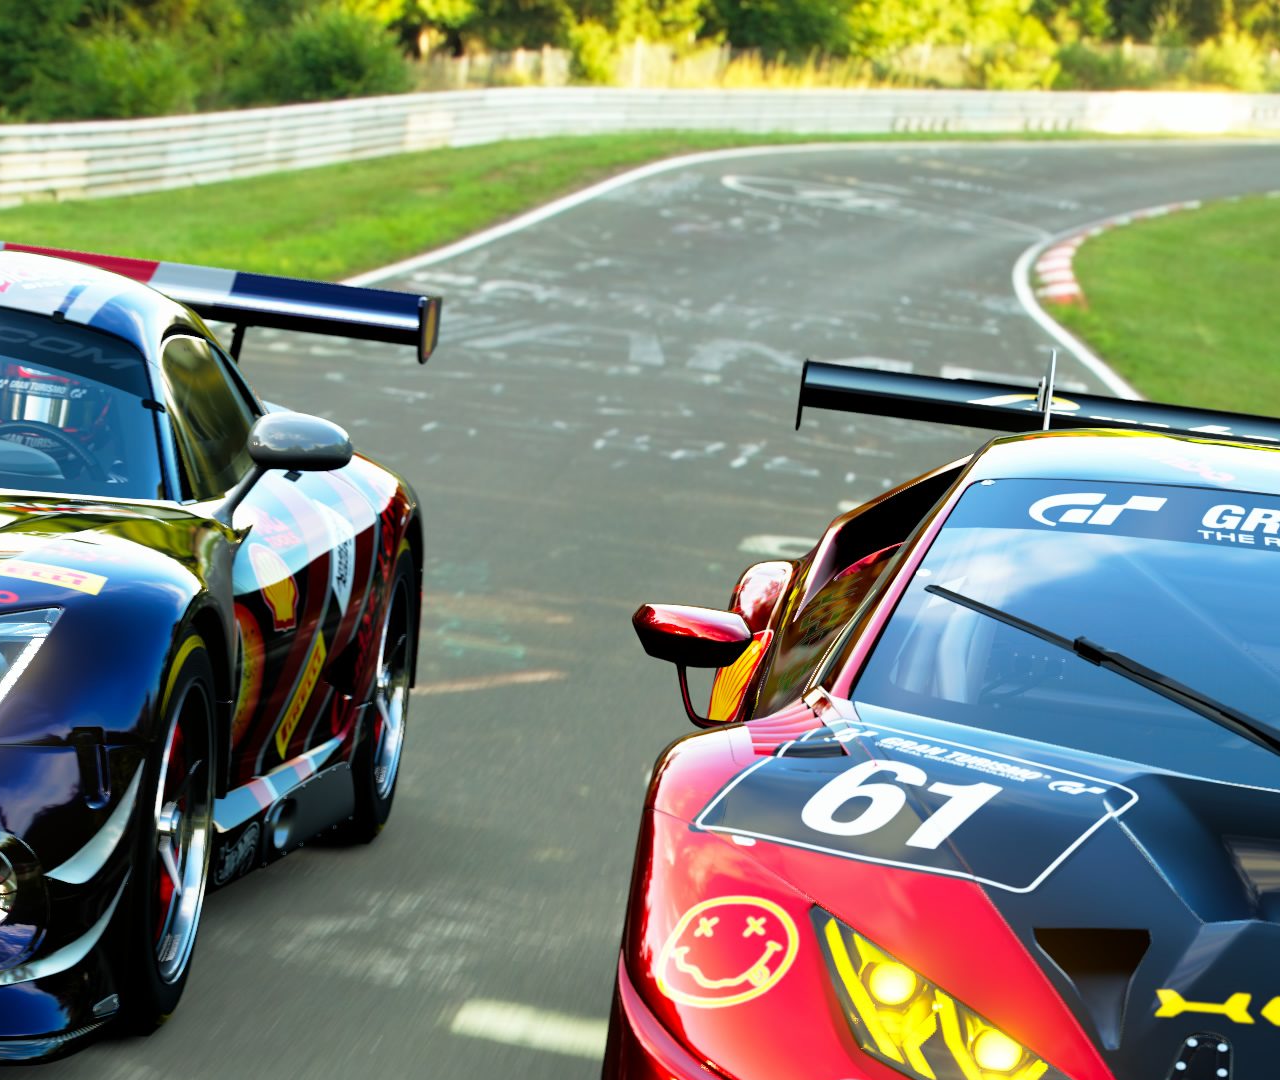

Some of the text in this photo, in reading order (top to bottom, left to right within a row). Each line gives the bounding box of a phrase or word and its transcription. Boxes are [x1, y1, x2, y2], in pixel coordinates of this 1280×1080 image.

[8, 379, 29, 391] GRAN
[29, 381, 68, 395] TURISMO
[1197, 529, 1257, 545] THE
[879, 736, 947, 757] GRAN
[800, 759, 1004, 849] 61
